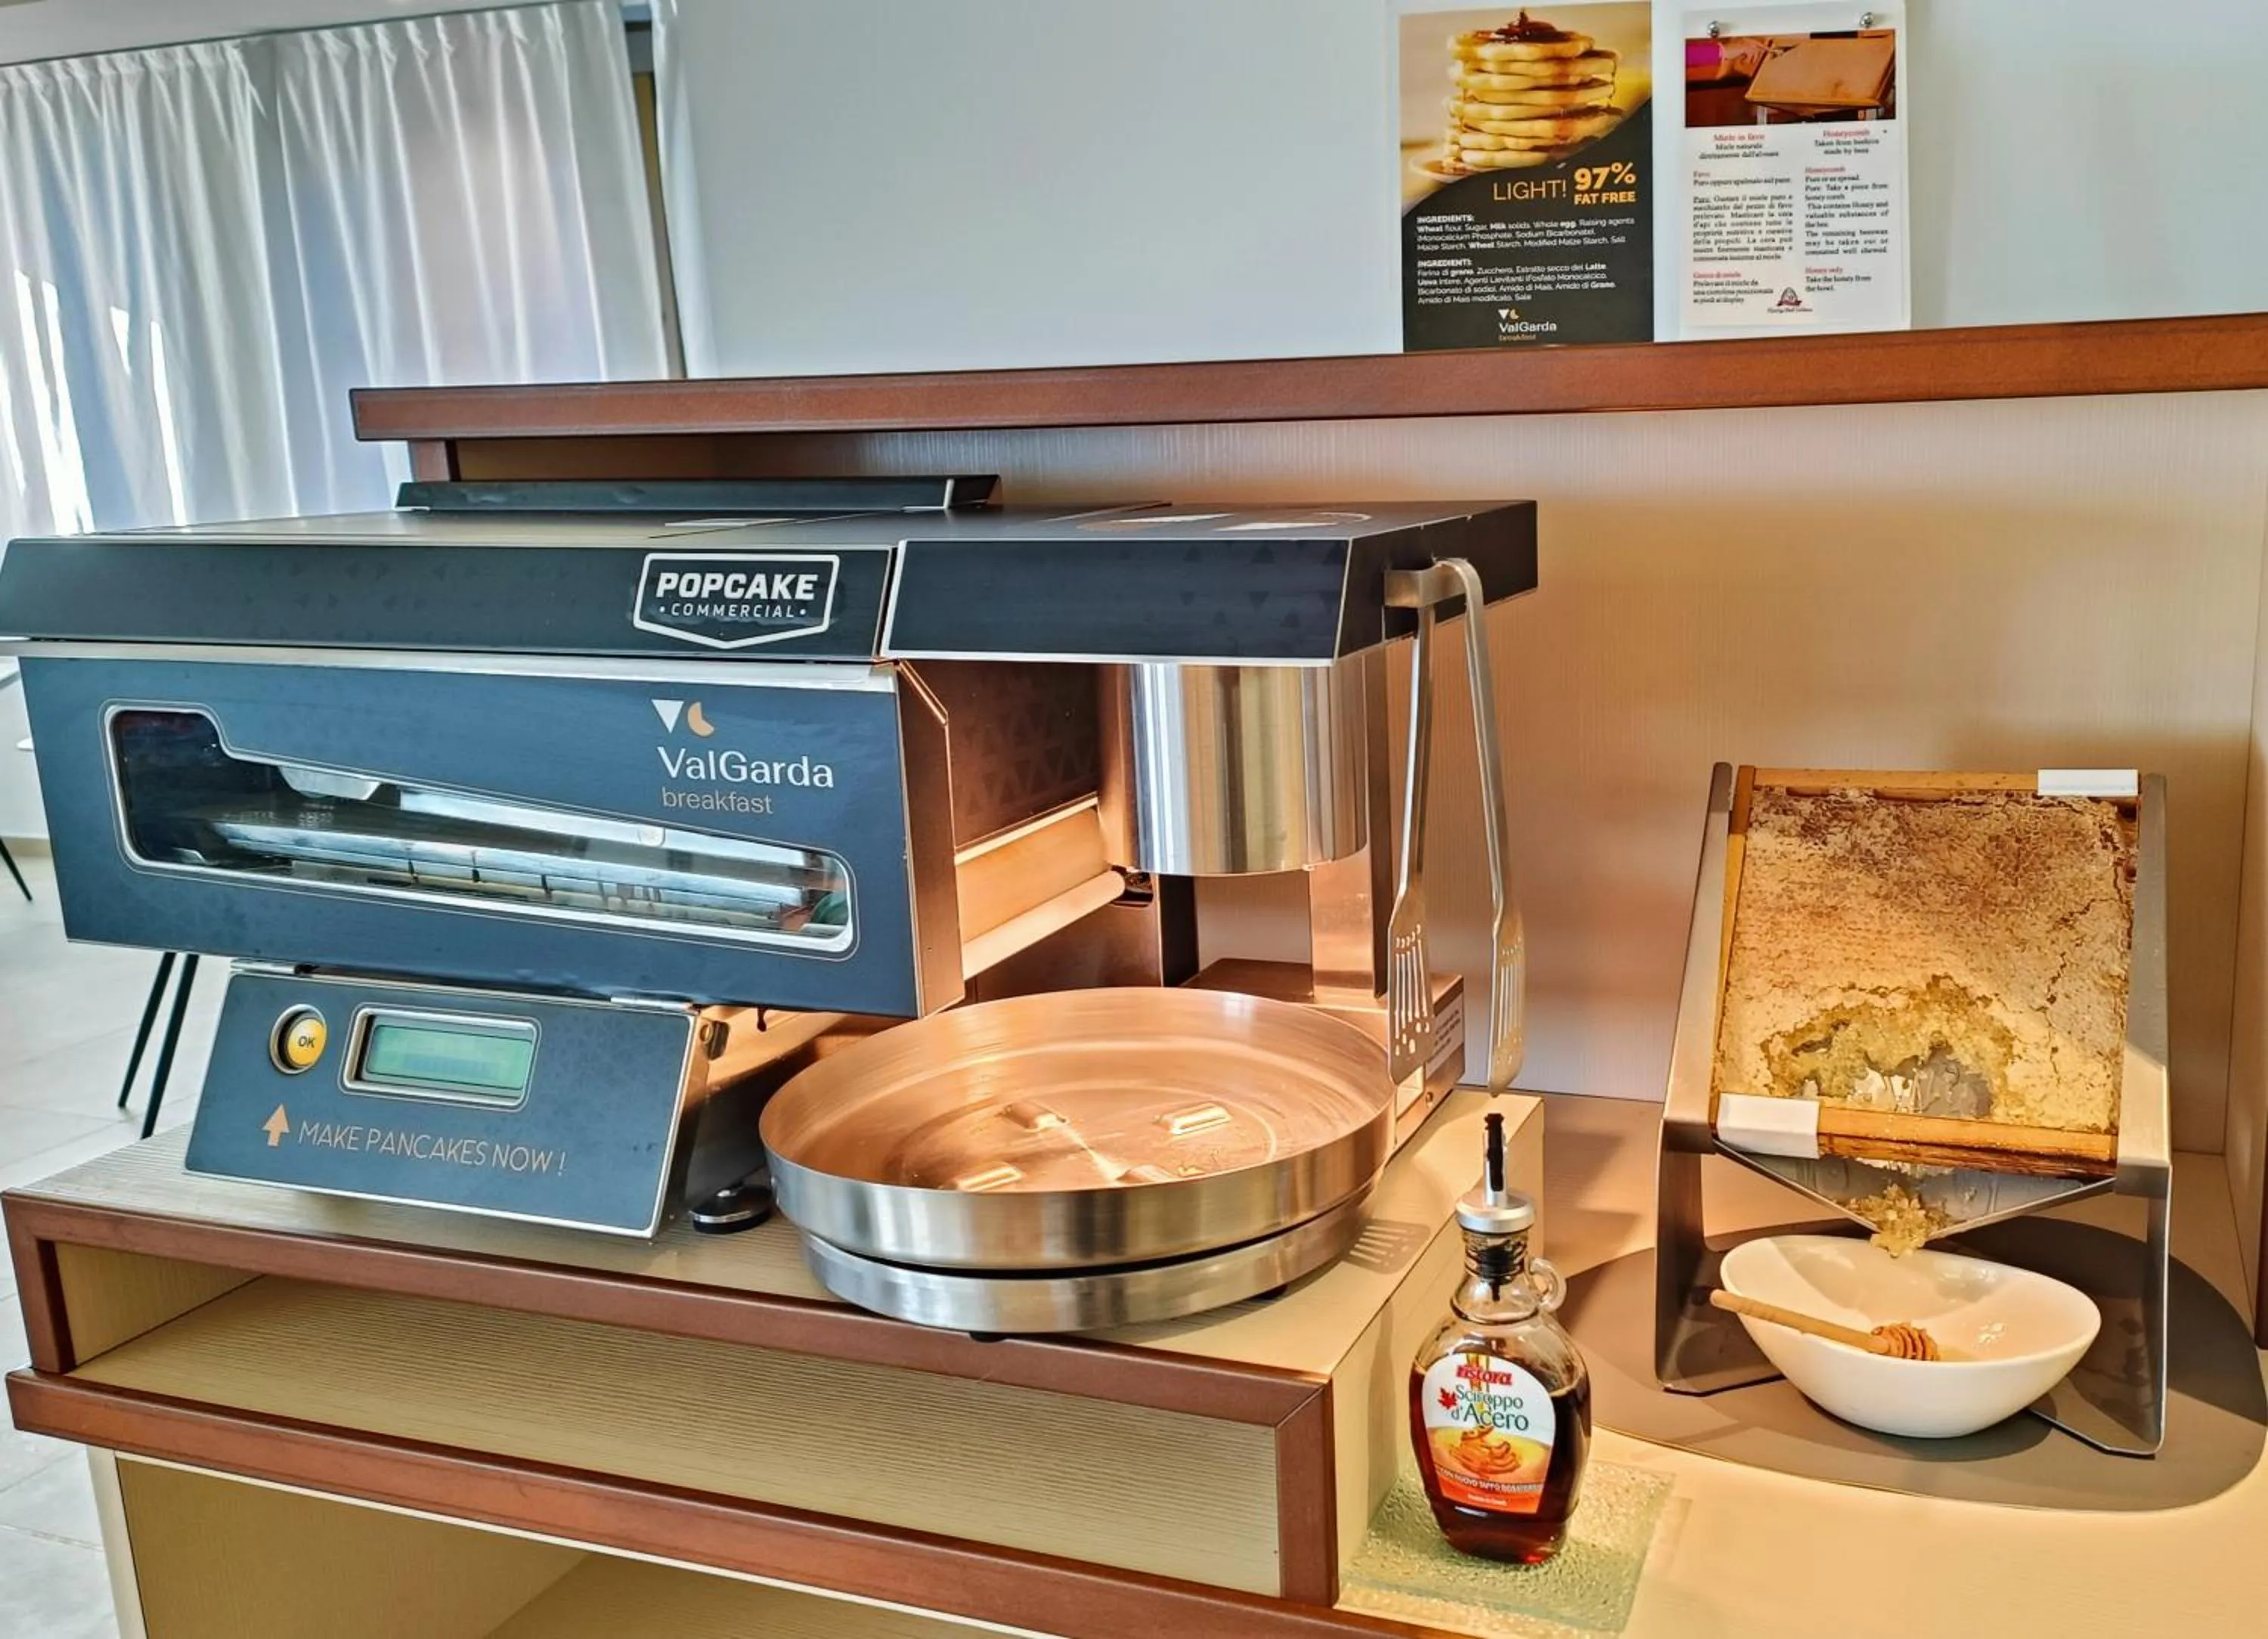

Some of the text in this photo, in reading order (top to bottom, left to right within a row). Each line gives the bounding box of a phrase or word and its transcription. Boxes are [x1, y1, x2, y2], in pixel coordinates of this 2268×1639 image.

[1574, 162, 1636, 191] 97%
[1493, 179, 1566, 200] LIGHT!
[1574, 191, 1636, 205] FAT FREE
[1417, 215, 1474, 225] INGREDIENTS:
[1417, 225, 1443, 233] Wheat
[1490, 222, 1507, 230] Milk
[1532, 220, 1559, 228] Whole
[1579, 218, 1606, 228] Raising
[1608, 217, 1635, 226] agents
[1515, 230, 1545, 238] Sodium
[1417, 243, 1440, 252] Maize
[1468, 240, 1495, 249] Wheat
[1524, 238, 1557, 247] Modified
[1558, 237, 1582, 246] Maize
[1418, 268, 1441, 277] Farina
[1442, 267, 1449, 276] di
[1547, 265, 1570, 273] secco
[1464, 275, 1489, 286] Agenti
[1805, 275, 1821, 283] Take
[1464, 285, 1472, 294] di
[1499, 283, 1524, 293] Amido
[1526, 283, 1533, 292] di
[1555, 281, 1581, 290] Amido
[1582, 280, 1589, 290] di
[1418, 296, 1442, 305] Amido
[1443, 295, 1452, 304] di
[1498, 321, 1557, 334] ValGarda
[655, 572, 819, 602] POPCAKE
[671, 603, 795, 618] COMMERCIAL
[656, 745, 834, 789] ValGarda
[662, 786, 774, 815] breakfast
[299, 1036, 316, 1049] OK
[299, 1120, 363, 1151] MAKE
[365, 1128, 487, 1166] PANCAKES
[491, 1144, 553, 1173] NOW
[1455, 1364, 1514, 1386] ristora
[1455, 1383, 1524, 1411] Sciroppo
[1451, 1402, 1530, 1432] d'Acero
